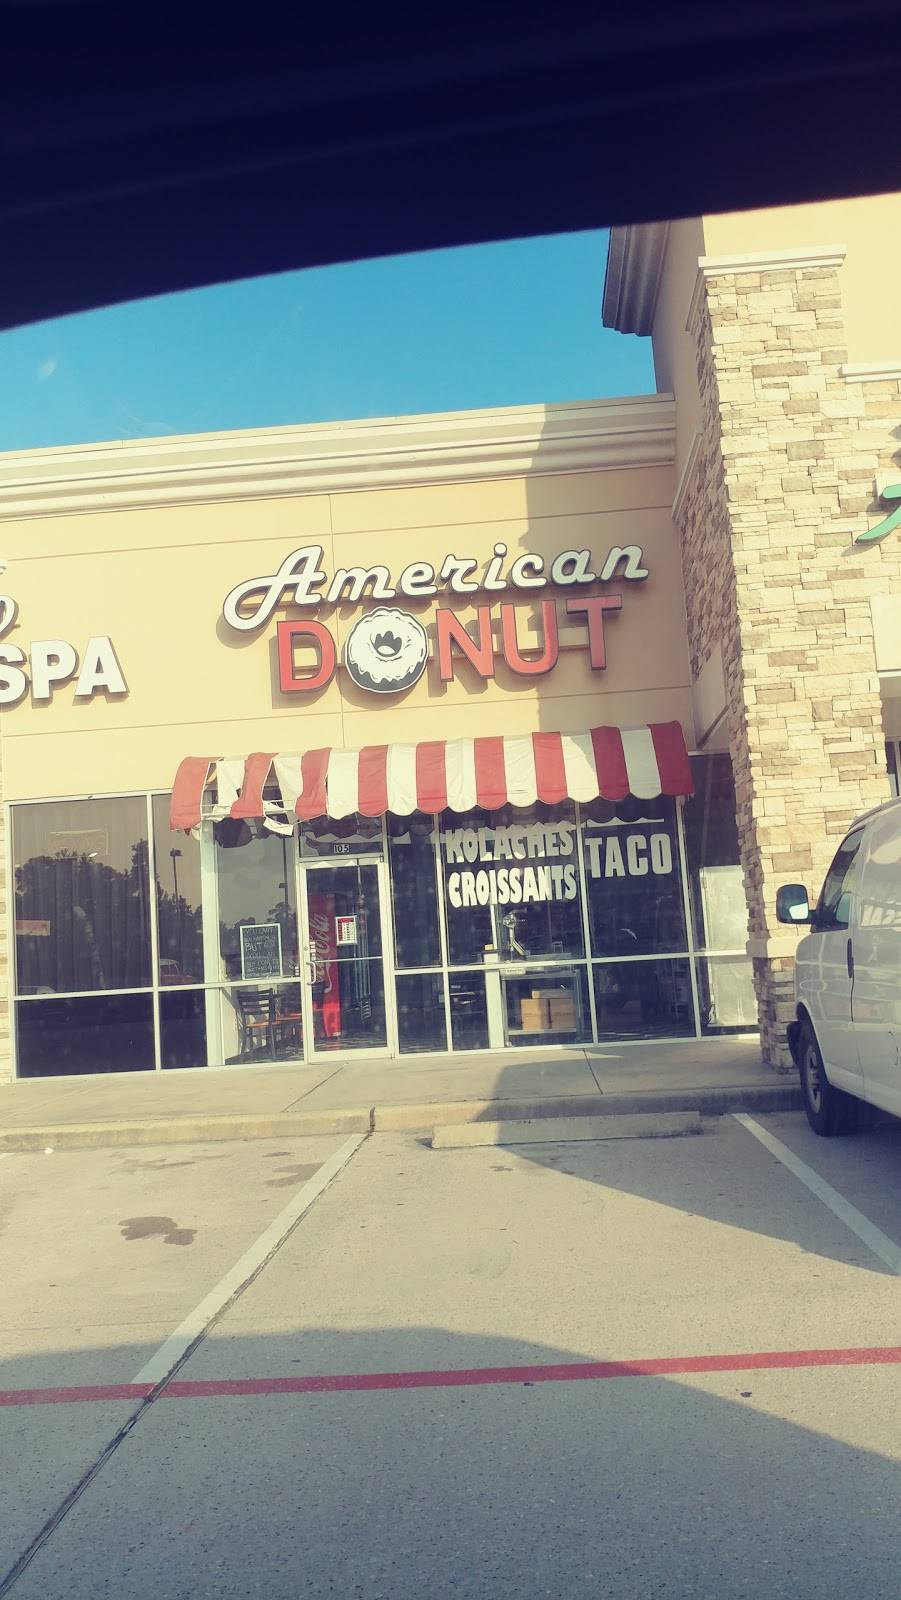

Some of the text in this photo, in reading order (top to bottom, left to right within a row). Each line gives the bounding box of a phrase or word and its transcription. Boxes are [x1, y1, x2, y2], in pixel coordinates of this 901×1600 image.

[222, 543, 649, 630] American
[276, 594, 622, 694] DONUT
[0, 636, 128, 704] SPA
[334, 843, 349, 853] 105
[445, 825, 575, 864] KOLACHES
[585, 833, 673, 878] TACO
[448, 863, 577, 908] CROISSANTS
